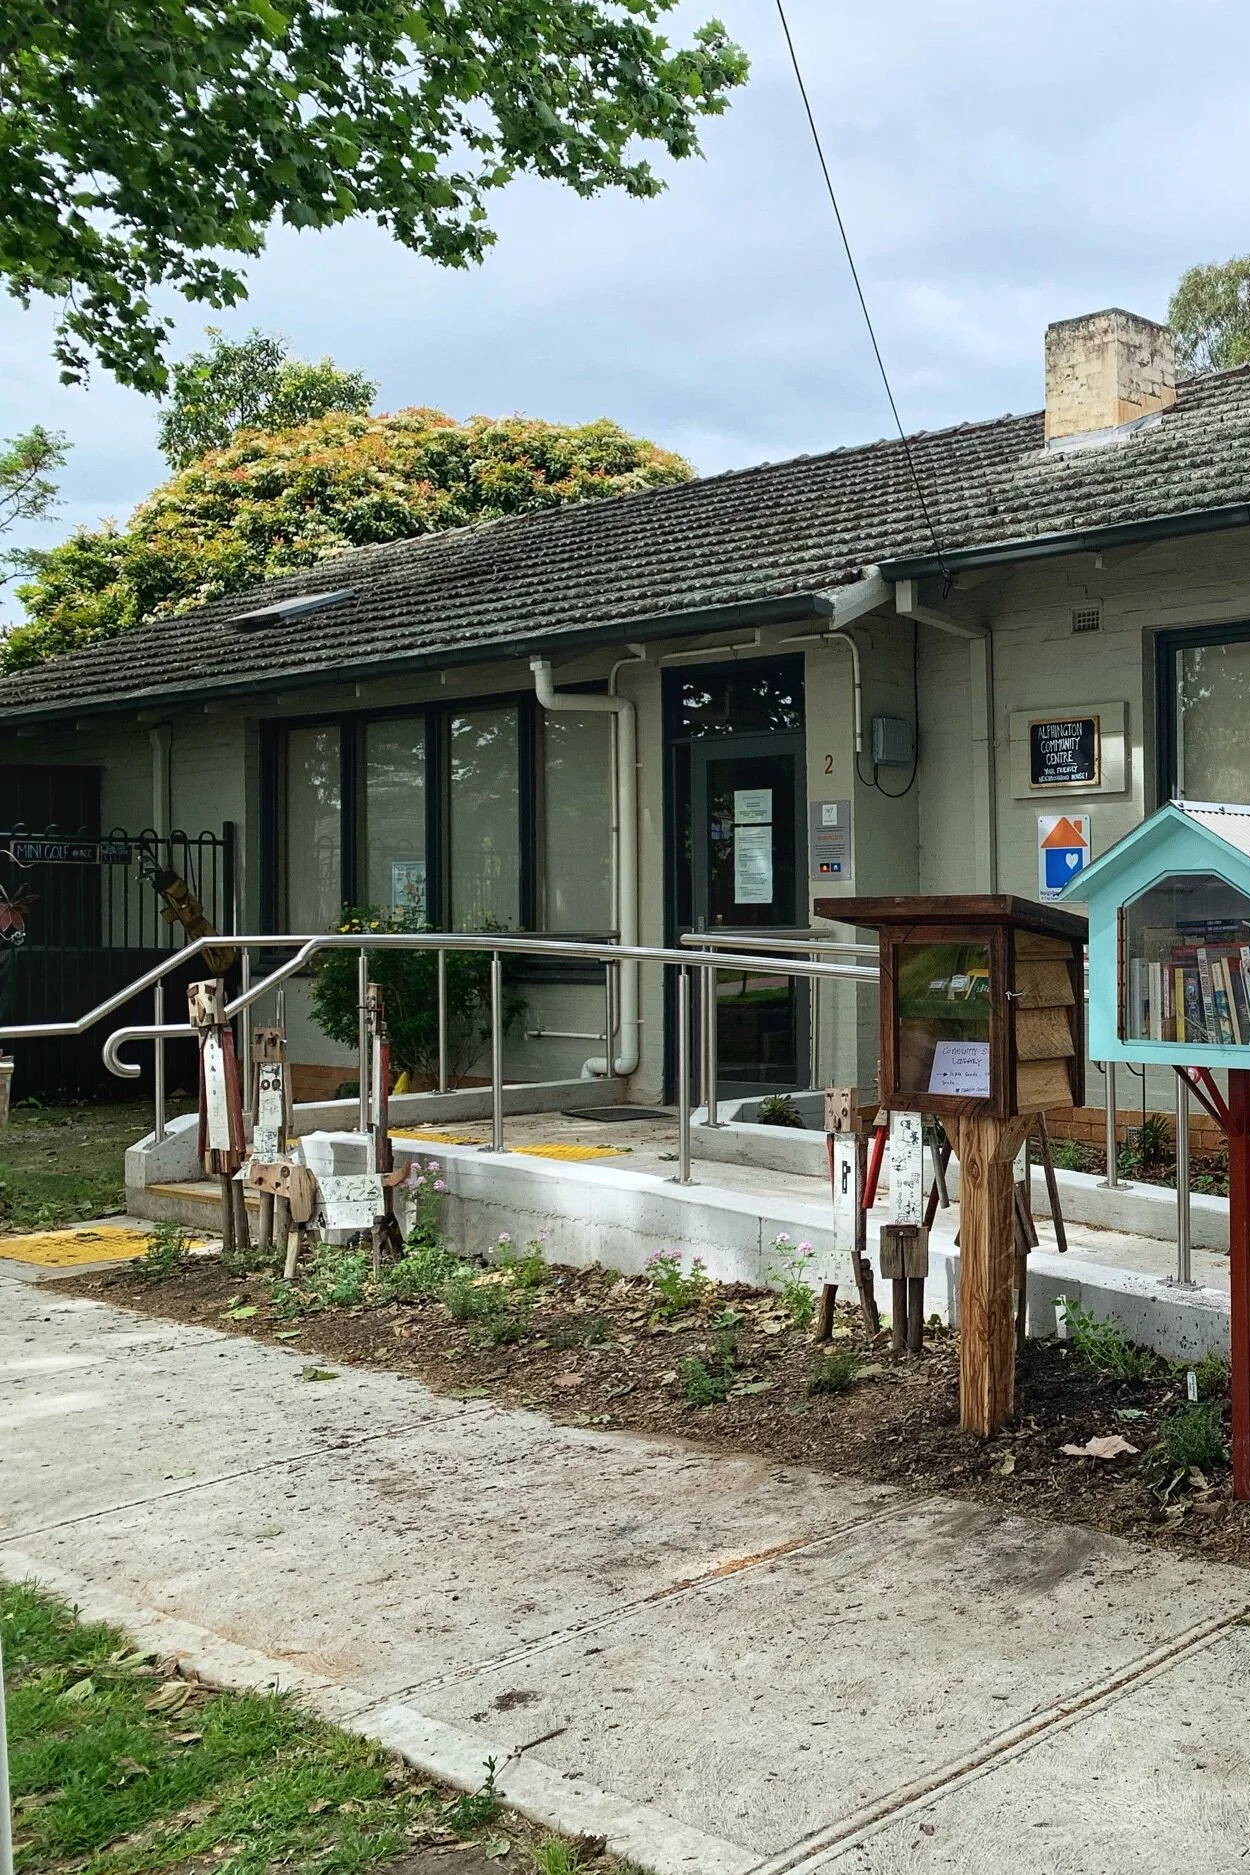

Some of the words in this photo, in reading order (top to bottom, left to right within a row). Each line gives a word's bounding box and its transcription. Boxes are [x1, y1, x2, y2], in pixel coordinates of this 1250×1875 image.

[1038, 722, 1083, 739] ALPHINGTON
[1040, 737, 1081, 753] COMMUNITY
[824, 754, 834, 775] 2
[1045, 751, 1074, 766] CENTRE
[16, 844, 42, 859] MINI
[44, 844, 70, 860] GOLF
